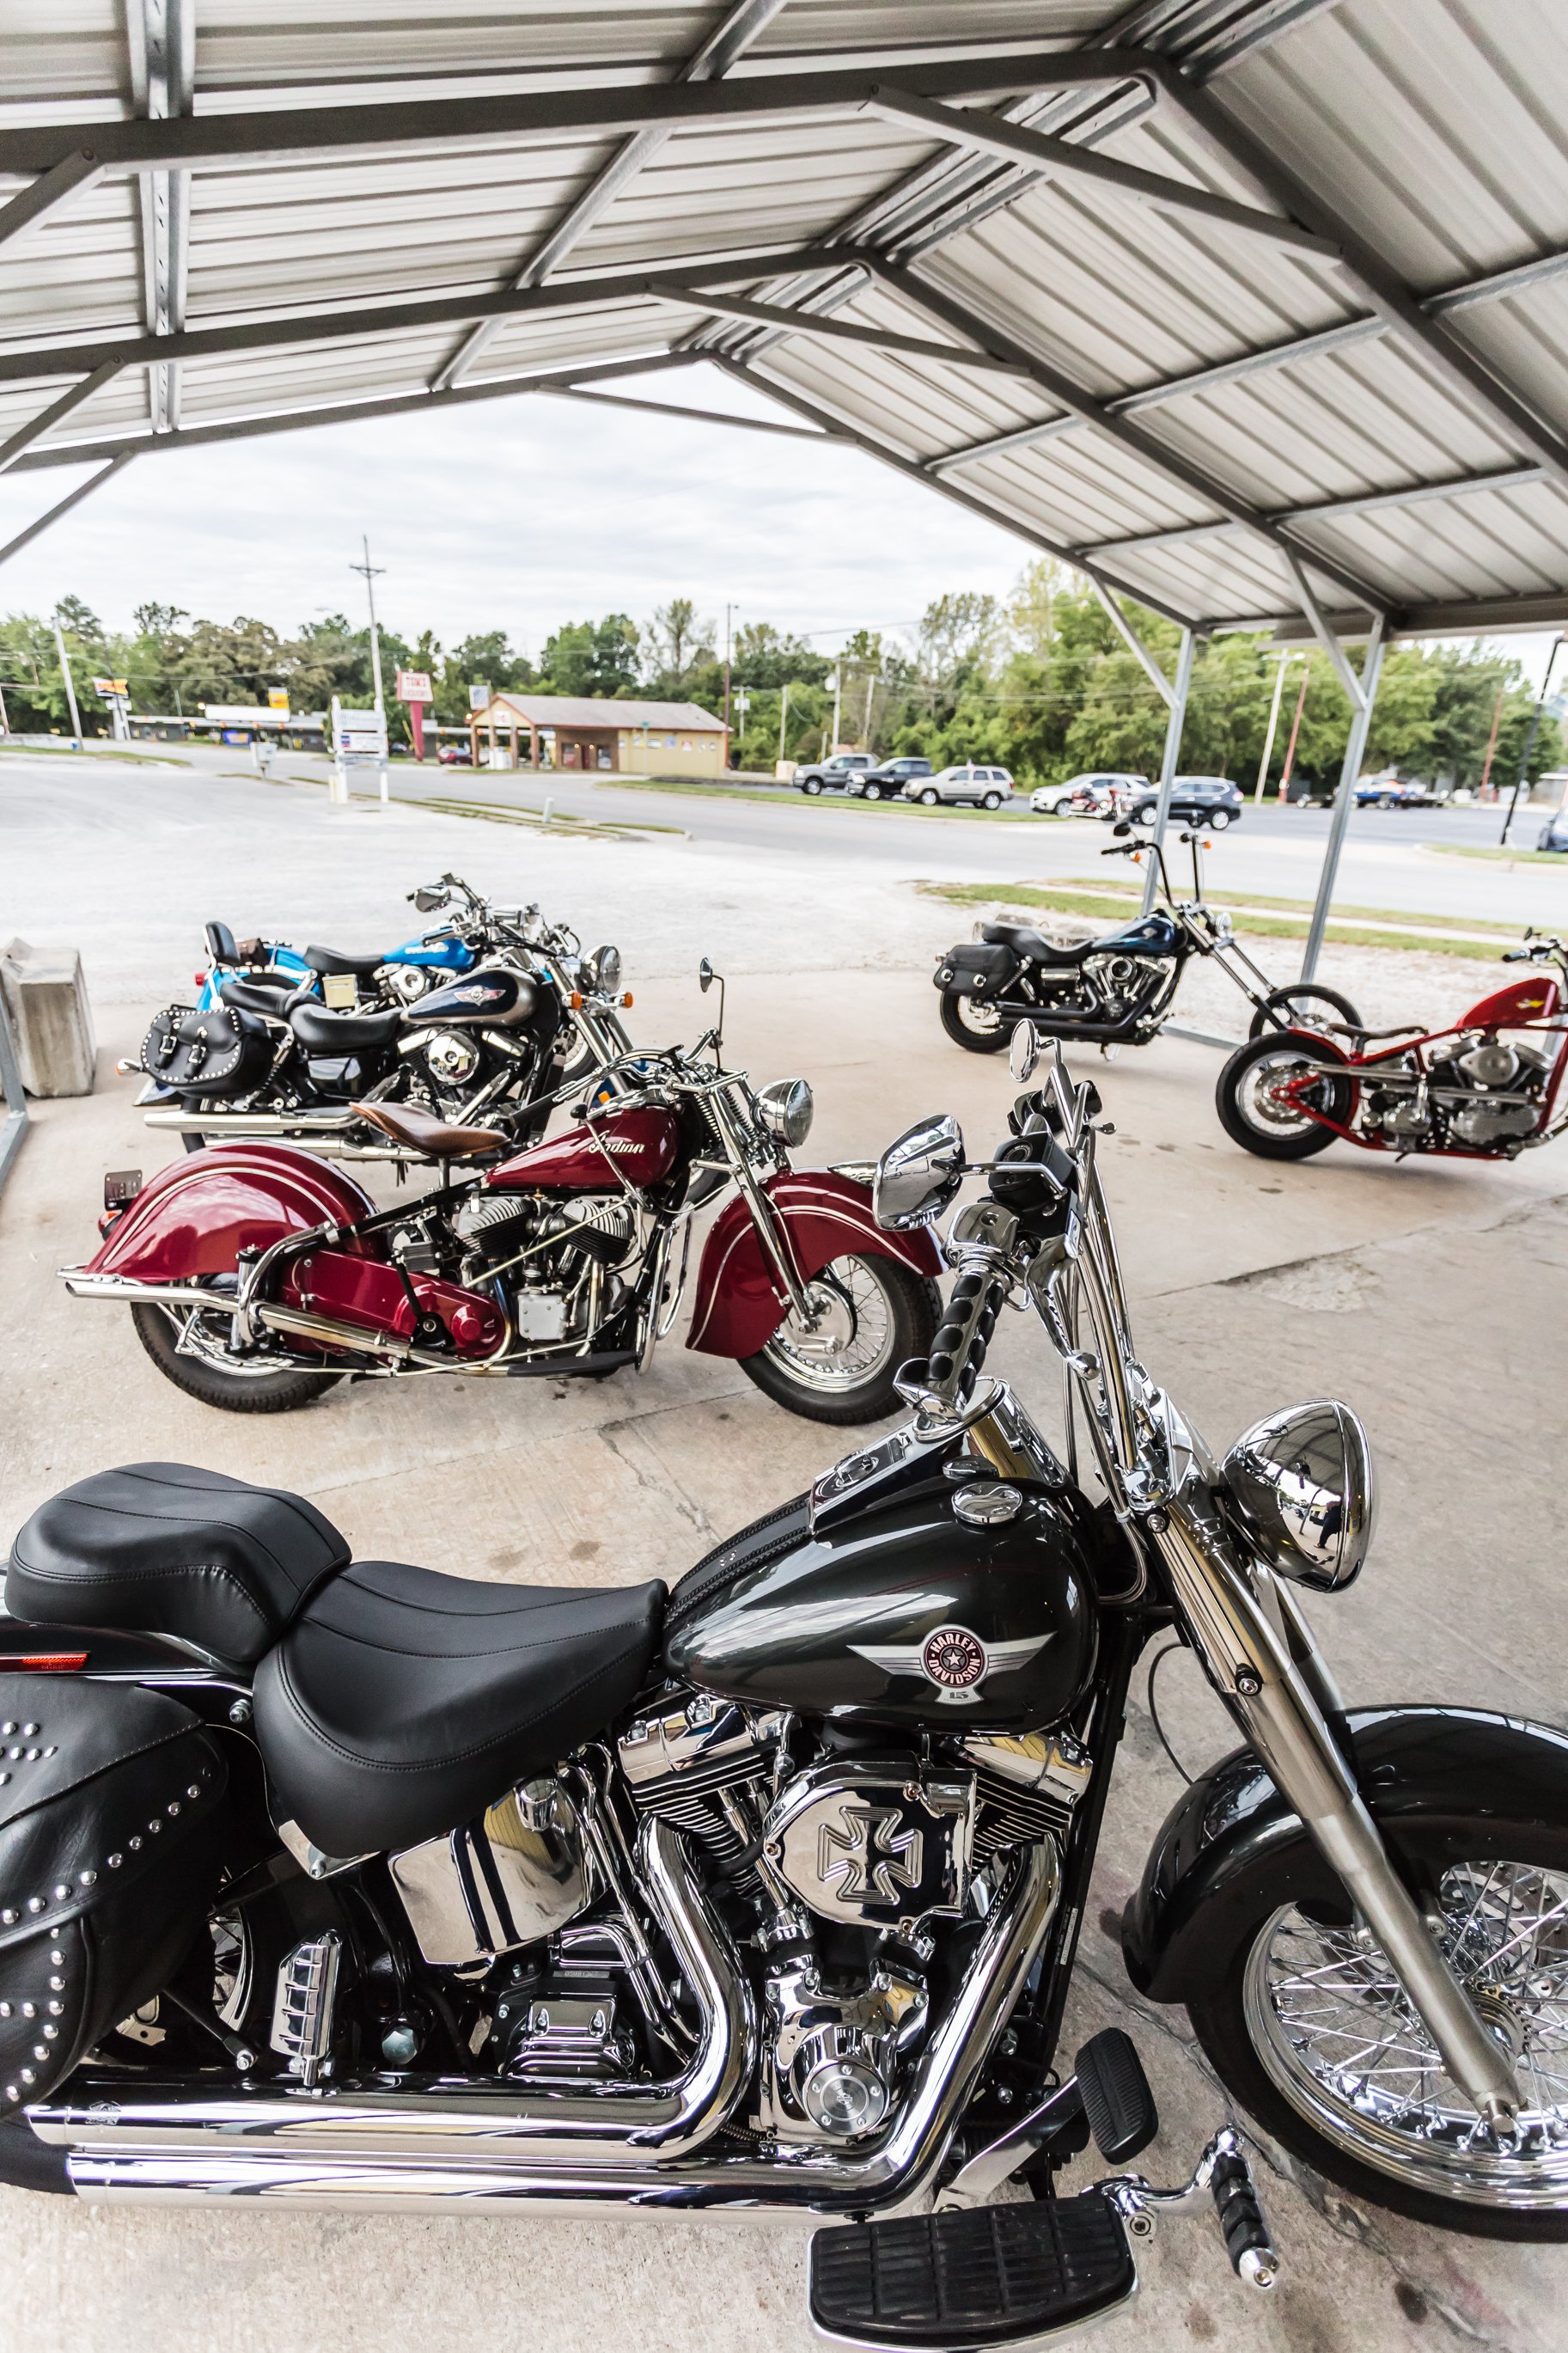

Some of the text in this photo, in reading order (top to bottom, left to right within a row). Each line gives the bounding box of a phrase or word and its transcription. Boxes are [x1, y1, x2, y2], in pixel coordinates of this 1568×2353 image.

[589, 1130, 645, 1153] Indian
[930, 1633, 976, 1653] HARLEY
[928, 1659, 980, 1684] DAVIDSON
